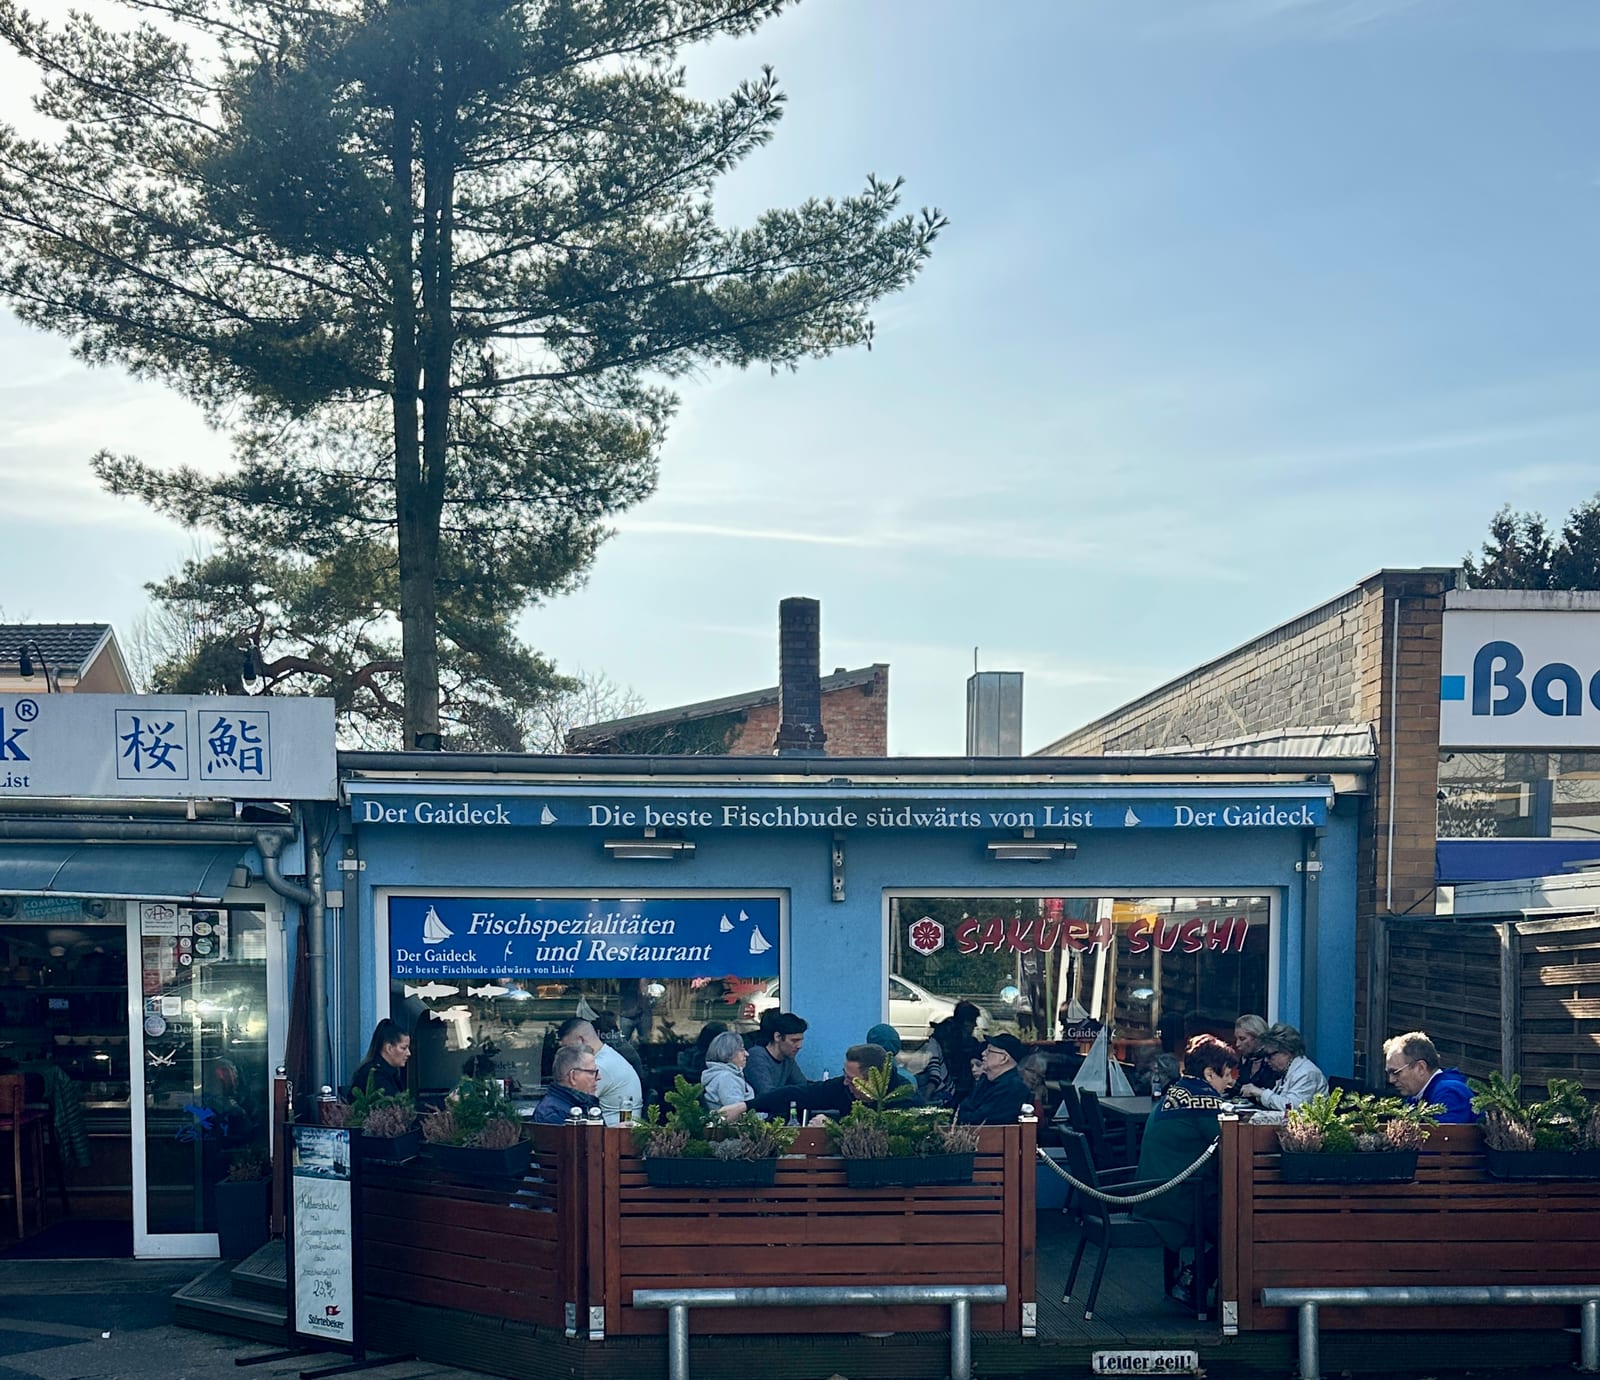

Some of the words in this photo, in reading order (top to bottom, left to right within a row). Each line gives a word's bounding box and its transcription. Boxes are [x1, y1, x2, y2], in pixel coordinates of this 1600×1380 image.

[1472, 640, 1600, 716] Ba
[363, 801, 407, 823] Der
[414, 802, 511, 825] Gaideck
[588, 804, 636, 826] Die
[644, 804, 713, 827] beste
[721, 805, 858, 828] Fischbude
[866, 806, 982, 828] südwärts
[990, 811, 1035, 827] von
[1043, 806, 1093, 827] List
[1174, 805, 1217, 827] Der
[1223, 804, 1314, 827] Gaideck
[467, 912, 676, 942] Fischspezialitäten
[954, 916, 1114, 955] SAKURA
[1126, 916, 1250, 955] SUSHI
[397, 948, 421, 962] Der
[424, 948, 477, 962] Gaideck
[535, 940, 583, 961] und
[586, 940, 713, 961] Restaurant
[397, 965, 413, 975] Die
[415, 965, 440, 975] beste
[442, 965, 489, 975] Fischbude
[491, 965, 531, 975] südwärts
[533, 966, 549, 975] von
[551, 965, 570, 975] List
[1098, 1355, 1150, 1370] Leider
[1154, 1355, 1192, 1371] geil!
